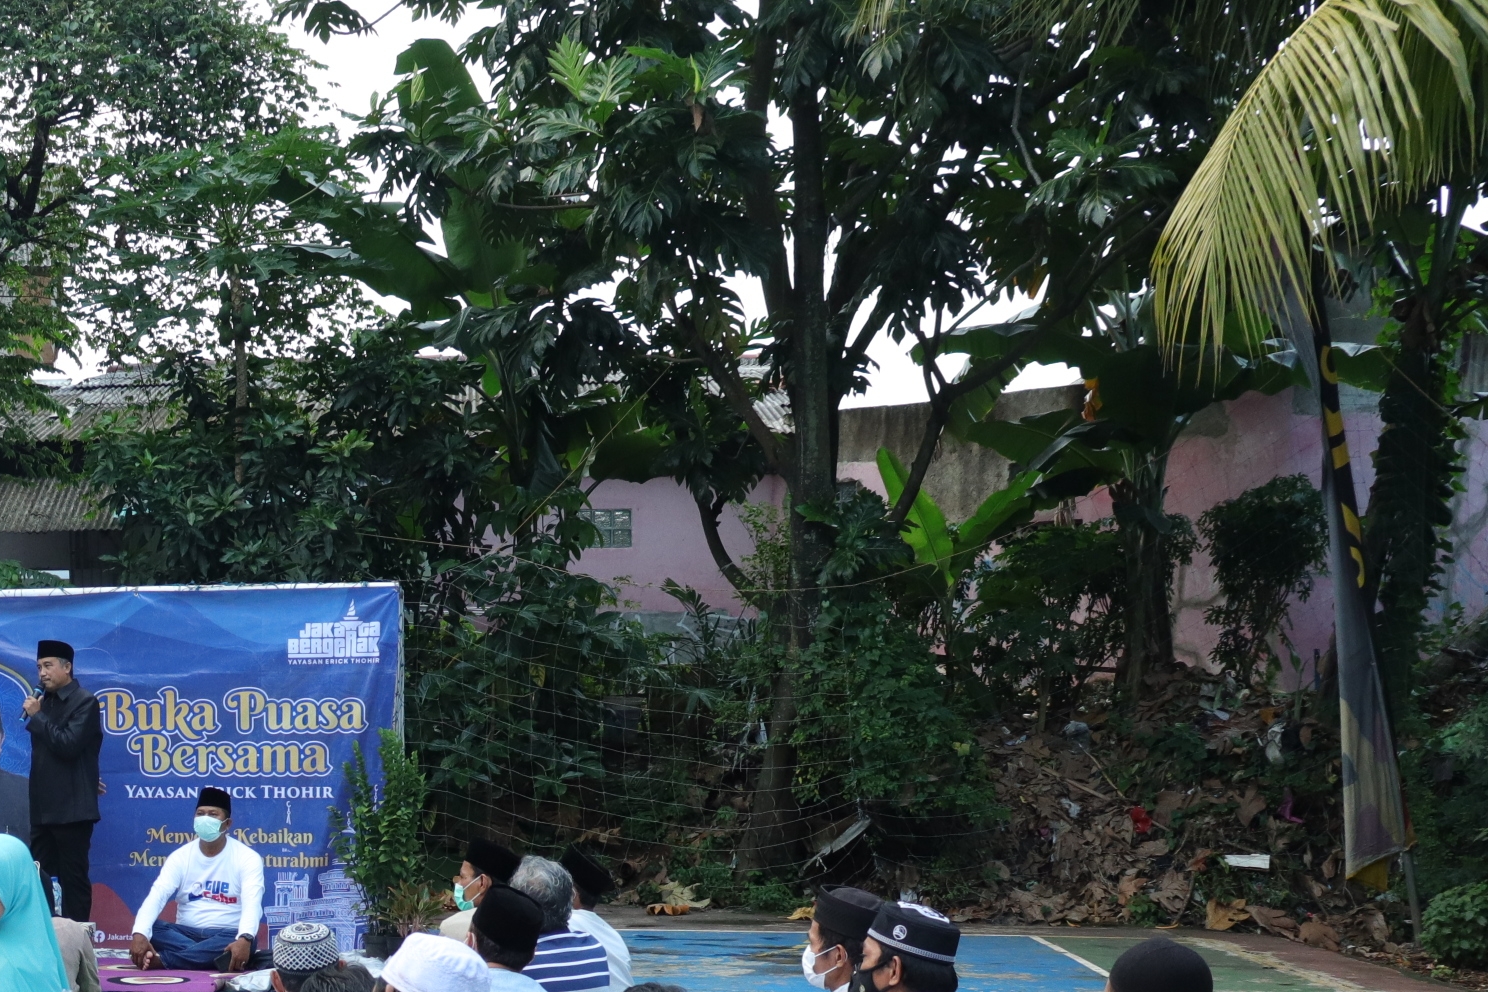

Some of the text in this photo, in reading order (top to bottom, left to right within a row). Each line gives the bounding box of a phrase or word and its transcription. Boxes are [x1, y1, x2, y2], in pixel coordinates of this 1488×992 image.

[97, 689, 366, 740] Buka Puasa
[129, 733, 330, 774] Bersama
[125, 785, 198, 799] YAYASAN
[260, 785, 335, 799] THOHIR
[233, 828, 314, 847] Kebaikan
